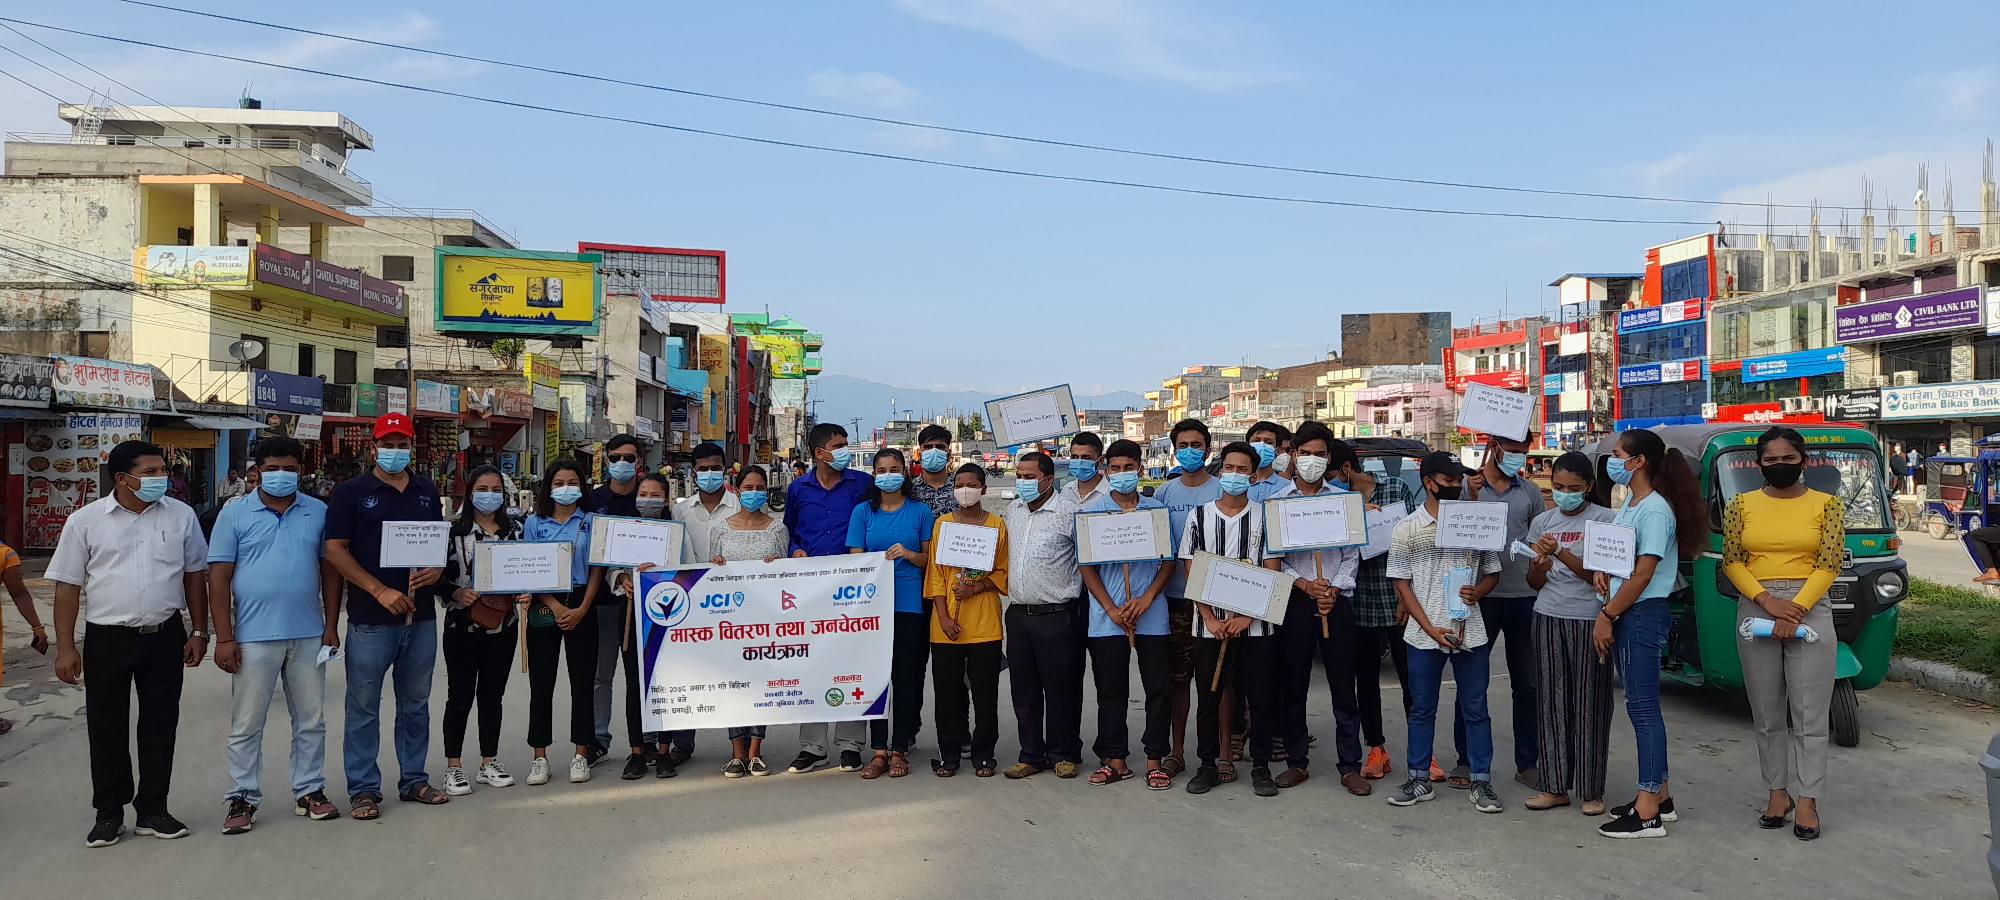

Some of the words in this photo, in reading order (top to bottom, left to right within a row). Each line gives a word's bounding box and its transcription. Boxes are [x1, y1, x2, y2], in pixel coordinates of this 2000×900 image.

[259, 259, 282, 276] ROYAL
[283, 267, 300, 281] STAG
[335, 274, 360, 291] SUPPLIERS
[363, 289, 381, 302] ROYAL
[382, 295, 395, 306] STAG
[1913, 304, 1936, 317] CIVIL
[1937, 302, 1958, 314] BANK
[1960, 299, 1979, 310] LTD.
[123, 365, 151, 387] होटल
[1902, 390, 1933, 401] गरिमा
[1938, 388, 1974, 400] विकास
[1977, 385, 1998, 397] बैंक
[1901, 401, 1937, 411] Garima
[1940, 399, 1969, 409] Bikas
[1972, 397, 2000, 407] Bank
[69, 412, 97, 429] होटल
[124, 415, 141, 429] होटल
[699, 593, 731, 609] JCI
[832, 585, 862, 601] JCI
[670, 626, 714, 643] मास्क
[718, 620, 771, 642] वितरण
[775, 621, 806, 638] तथा
[811, 613, 881, 636] जनचेतना
[742, 640, 810, 661] कार्यक्रम
[717, 681, 727, 690] गते
[766, 678, 800, 687] आयोजक
[832, 674, 862, 683] समन्वय
